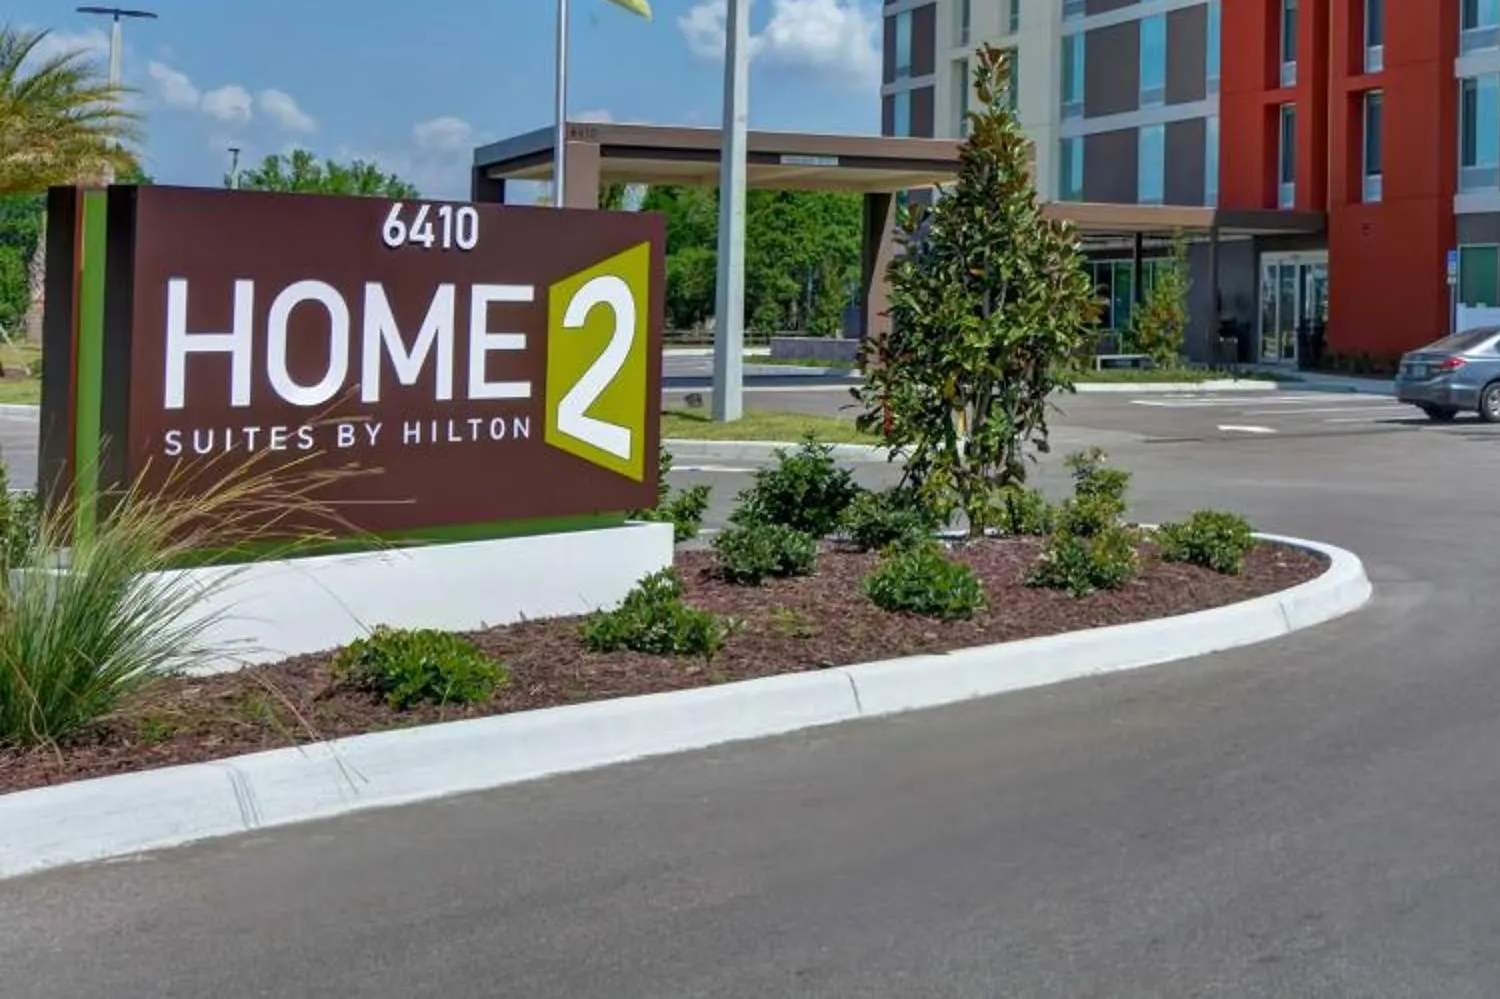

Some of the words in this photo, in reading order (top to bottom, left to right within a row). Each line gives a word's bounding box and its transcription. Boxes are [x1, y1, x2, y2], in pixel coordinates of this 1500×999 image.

[381, 203, 479, 251] 6410
[163, 277, 535, 410] HOME
[556, 275, 637, 461] 2
[163, 425, 315, 456] SUITES
[337, 423, 383, 448] BY
[402, 416, 531, 445] HILTON
